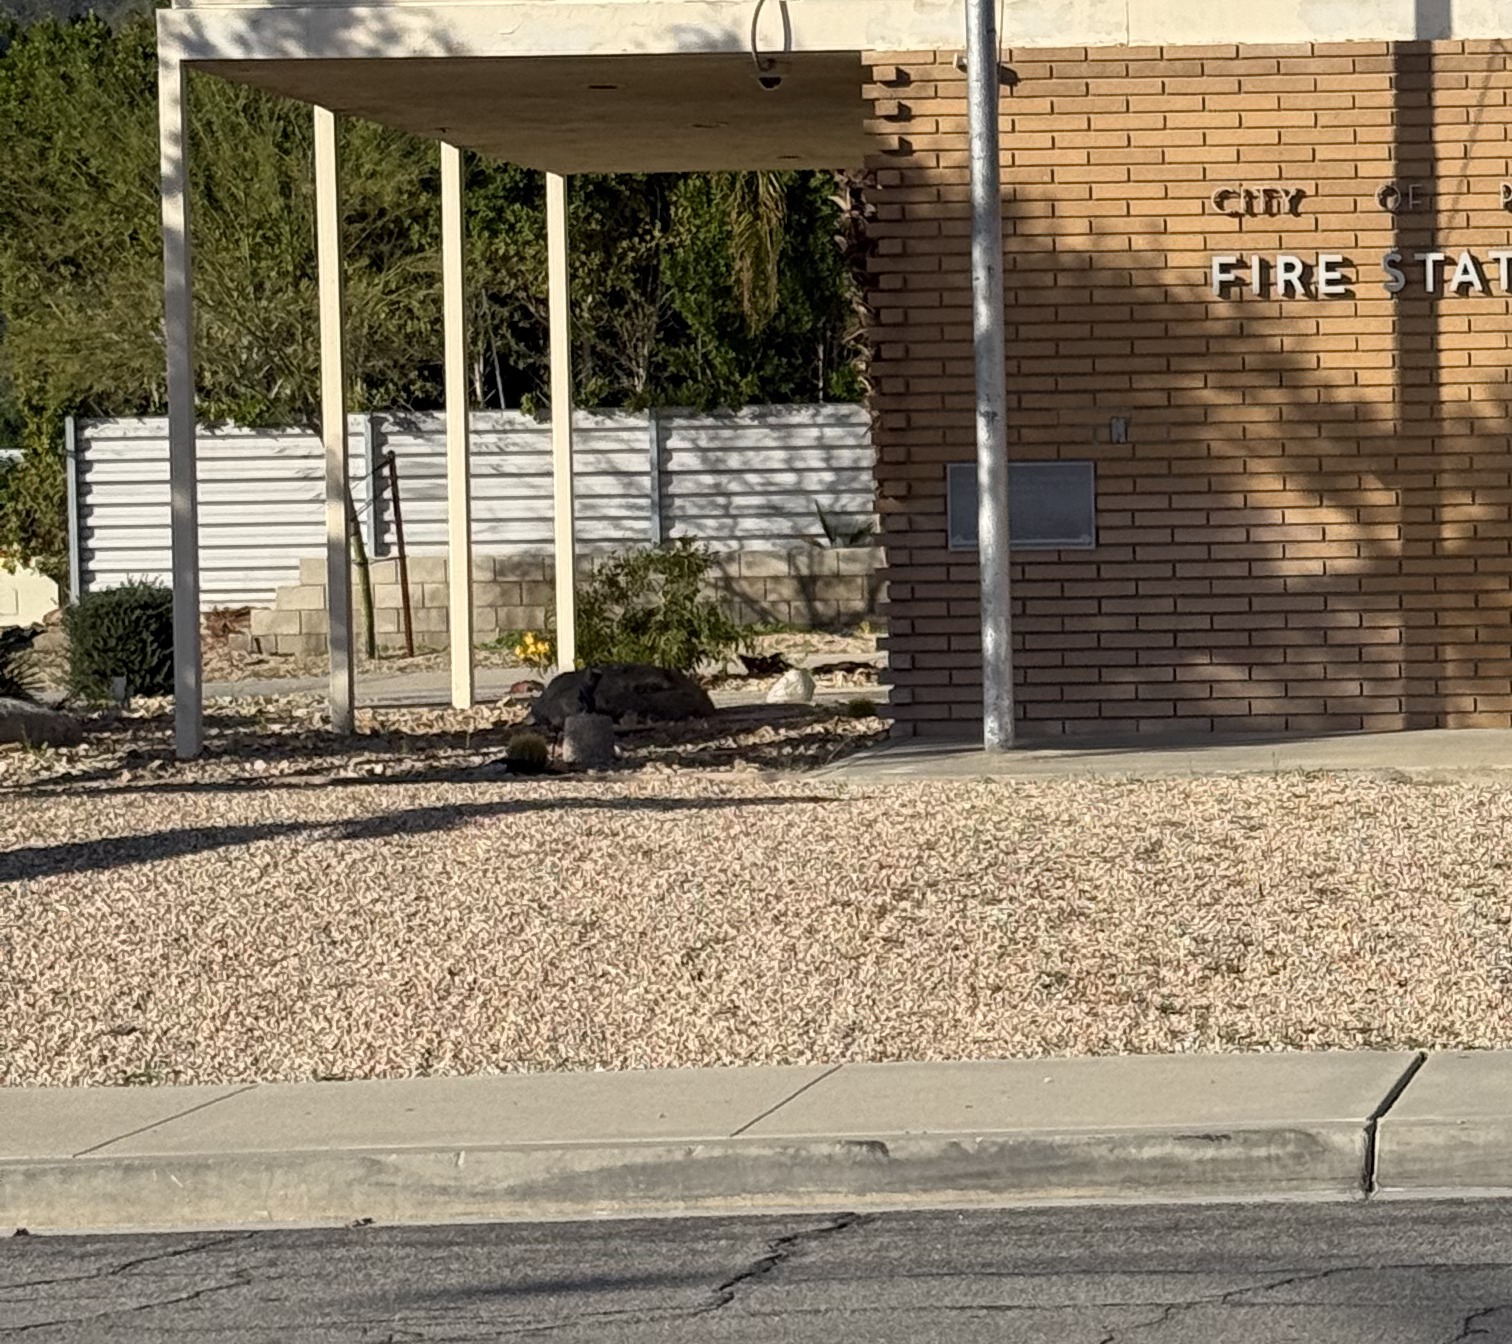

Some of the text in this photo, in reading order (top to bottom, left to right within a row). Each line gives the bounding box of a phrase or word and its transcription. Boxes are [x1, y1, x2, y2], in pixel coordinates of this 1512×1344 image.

[1211, 185, 1302, 214] CITY
[1375, 184, 1422, 210] OF
[1212, 254, 1346, 295] FIRE
